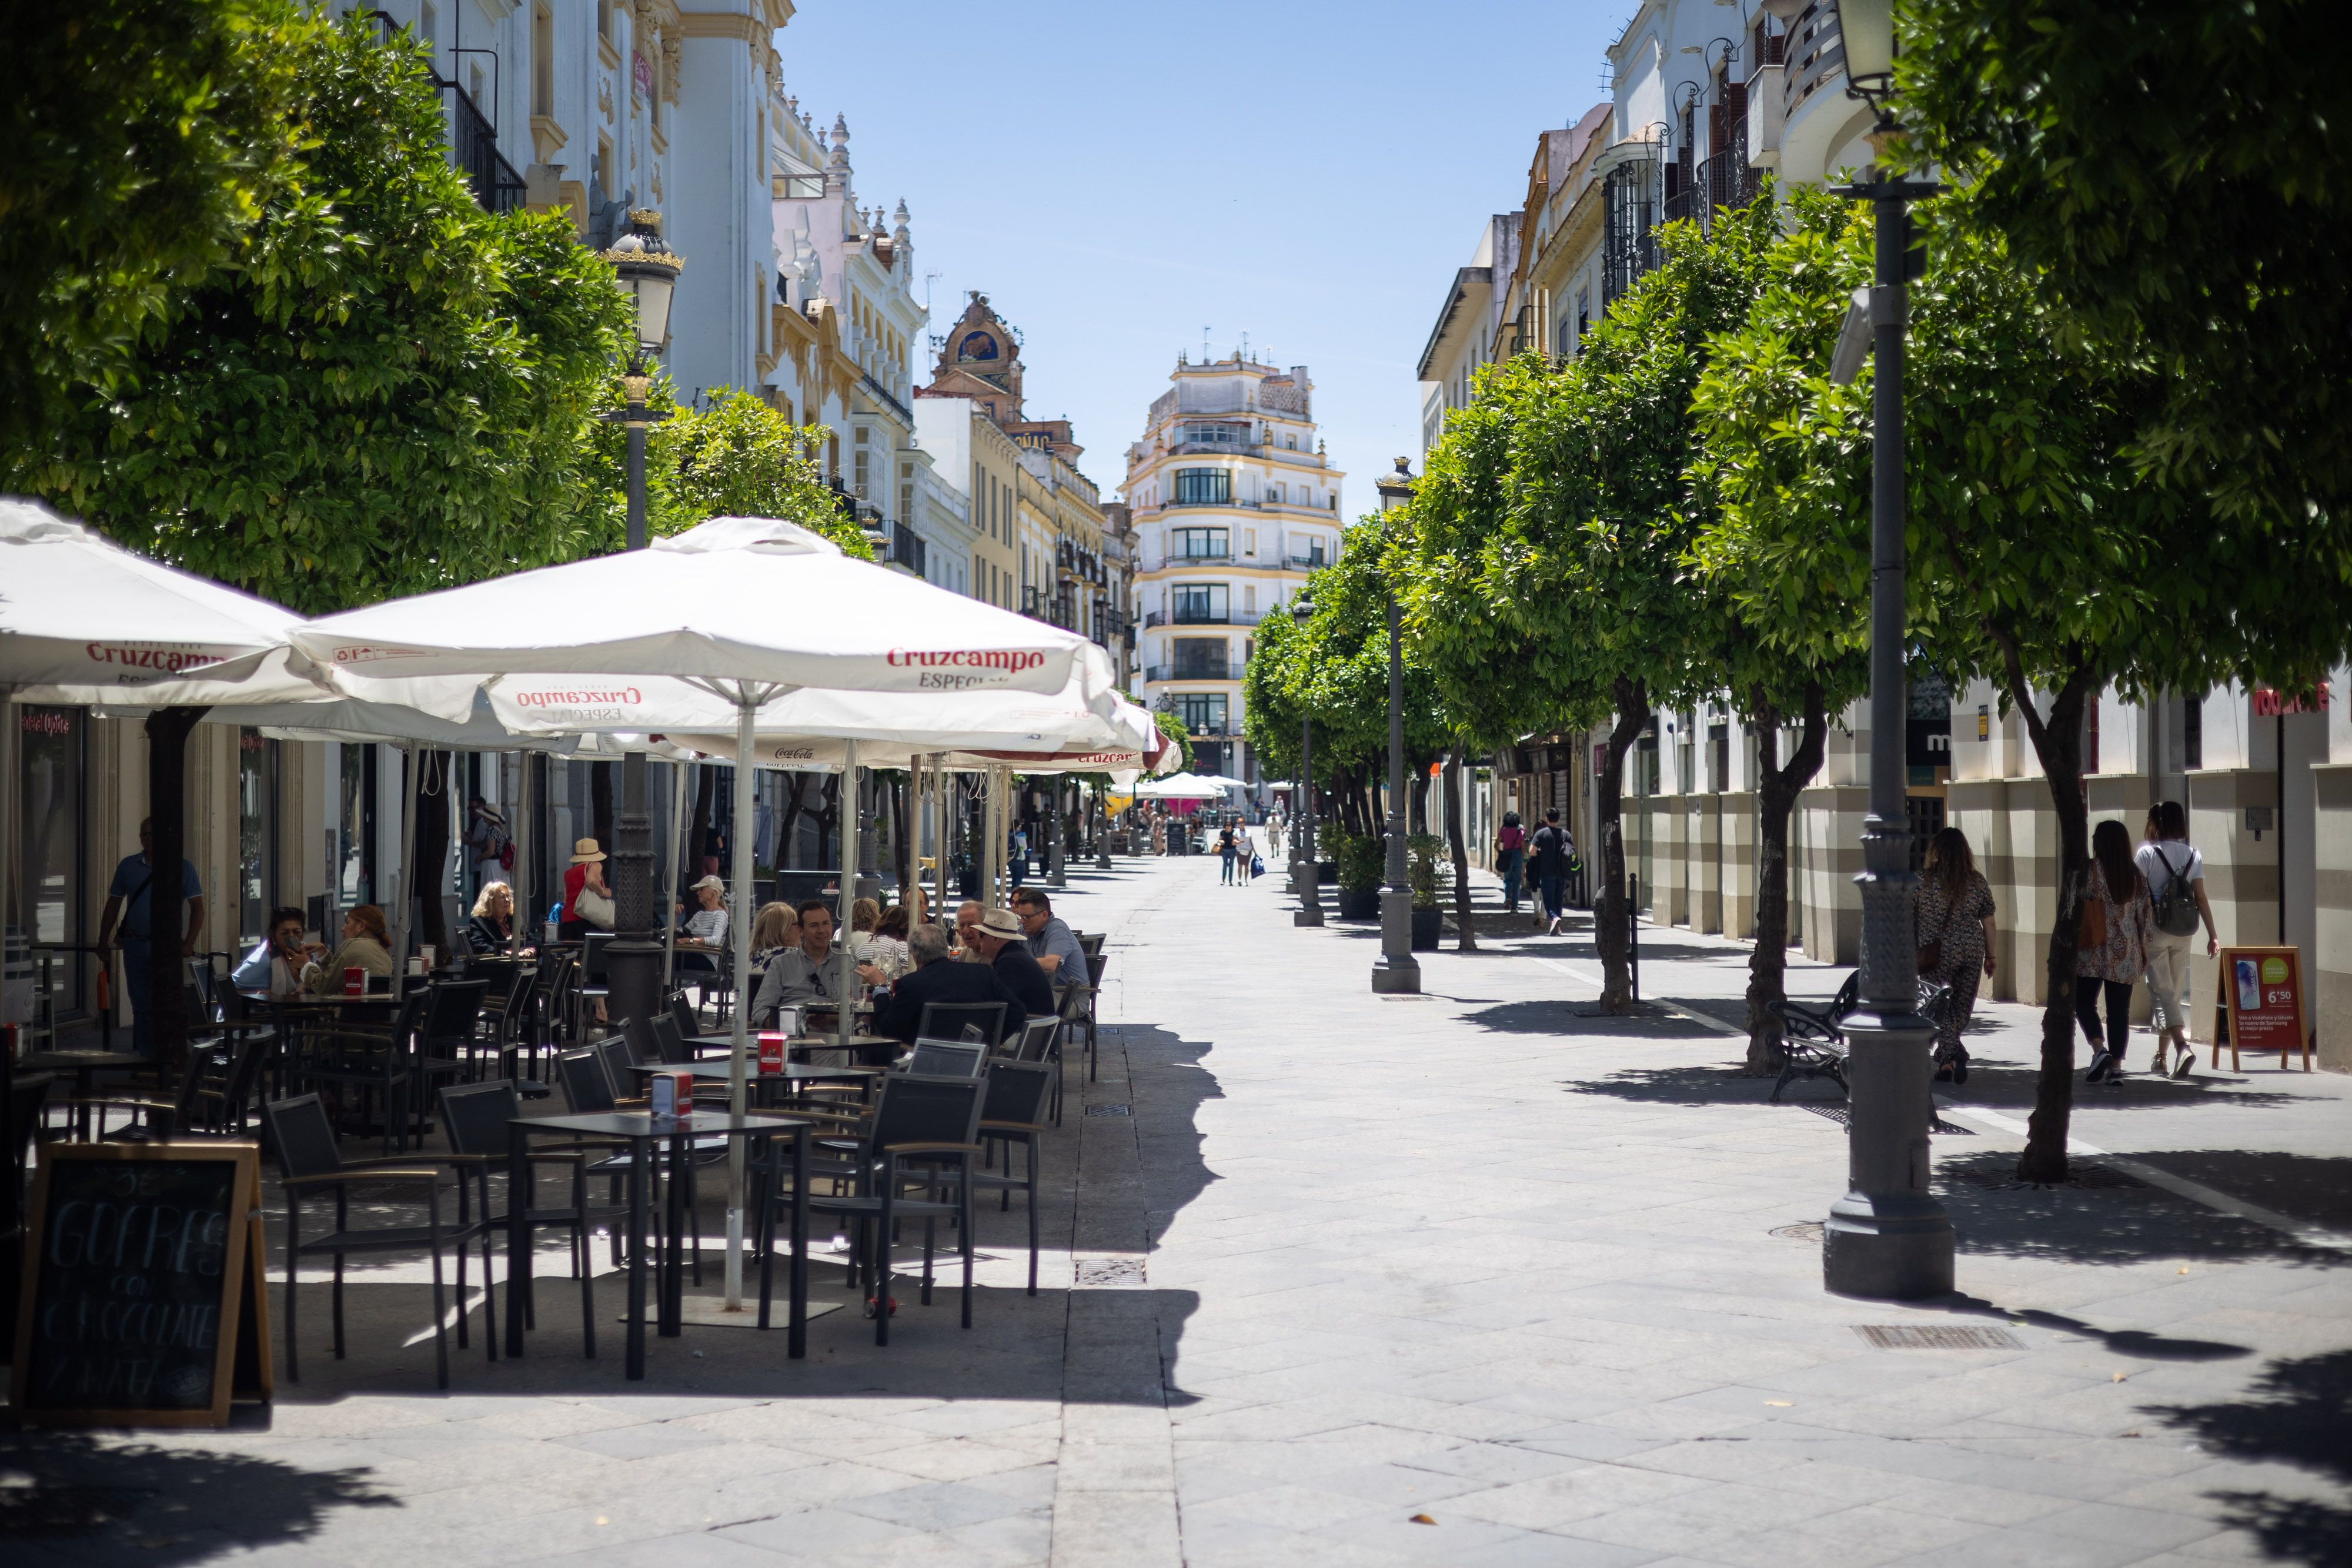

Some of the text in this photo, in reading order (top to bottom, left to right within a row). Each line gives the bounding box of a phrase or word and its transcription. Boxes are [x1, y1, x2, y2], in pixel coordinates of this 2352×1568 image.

[86, 642, 227, 671] Cruzcam
[887, 647, 1044, 674] Cruzcampo
[775, 748, 814, 759] Coca-Cola
[51, 1200, 226, 1275] GOFRES
